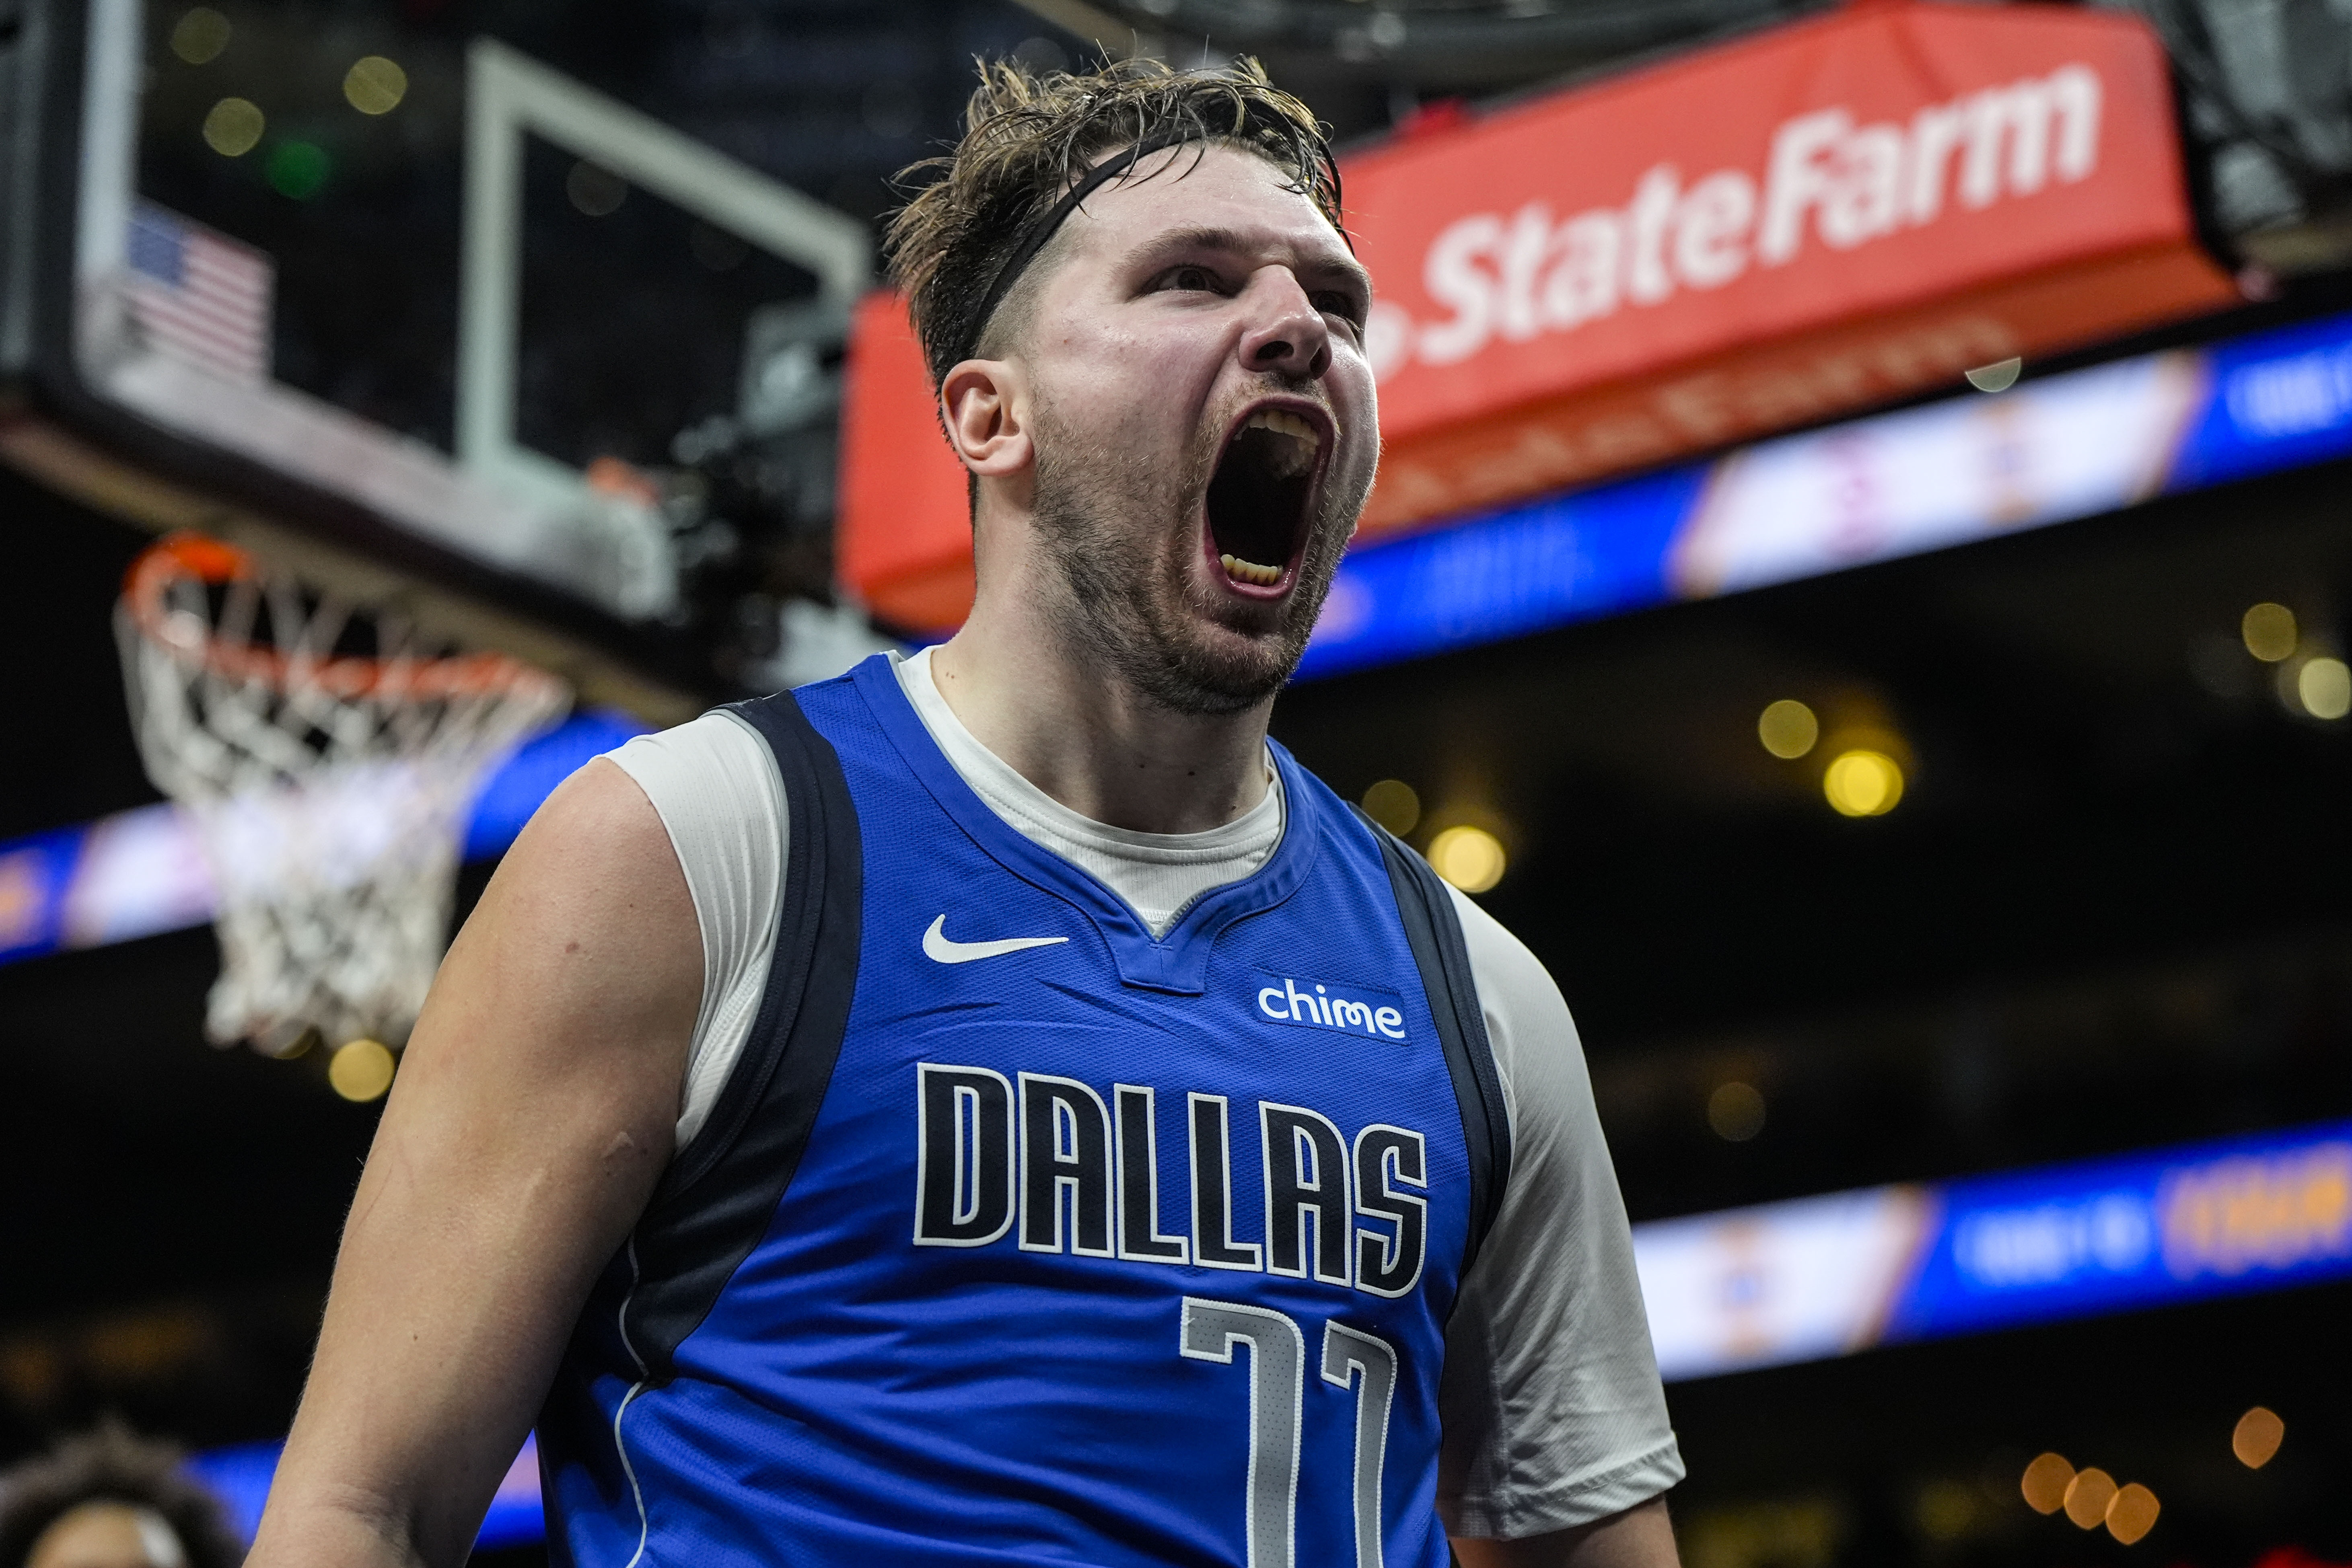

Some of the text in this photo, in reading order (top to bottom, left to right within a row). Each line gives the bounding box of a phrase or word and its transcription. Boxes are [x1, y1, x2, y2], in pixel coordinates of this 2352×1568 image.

[1417, 63, 2102, 365] StateFarm
[1258, 978, 1405, 1039] chime
[913, 1062, 1428, 1298] DALLAS
[1179, 1296, 1397, 1568] 77
